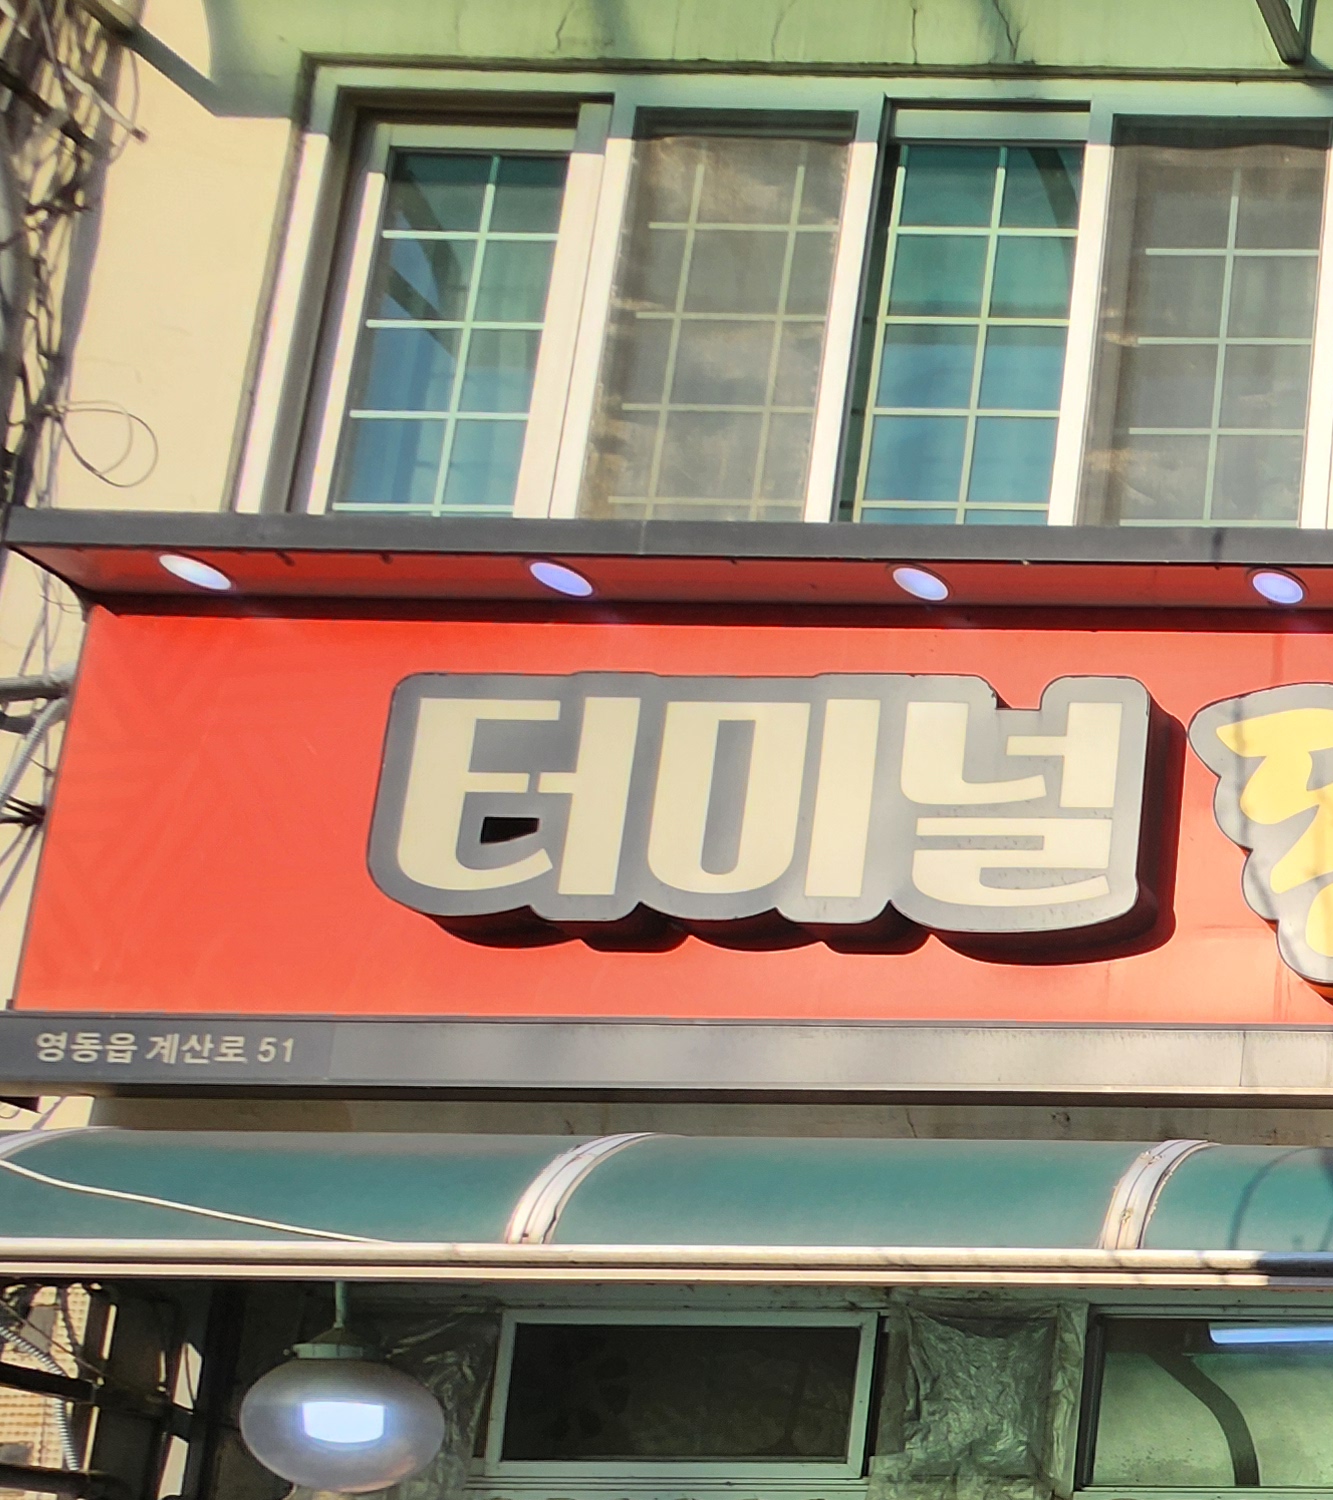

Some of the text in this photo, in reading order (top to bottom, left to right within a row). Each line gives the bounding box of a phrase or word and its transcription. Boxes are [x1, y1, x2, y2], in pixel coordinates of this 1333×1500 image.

[390, 690, 1130, 912] 터미널
[35, 1030, 297, 1066] 영동읍 계산로 51
